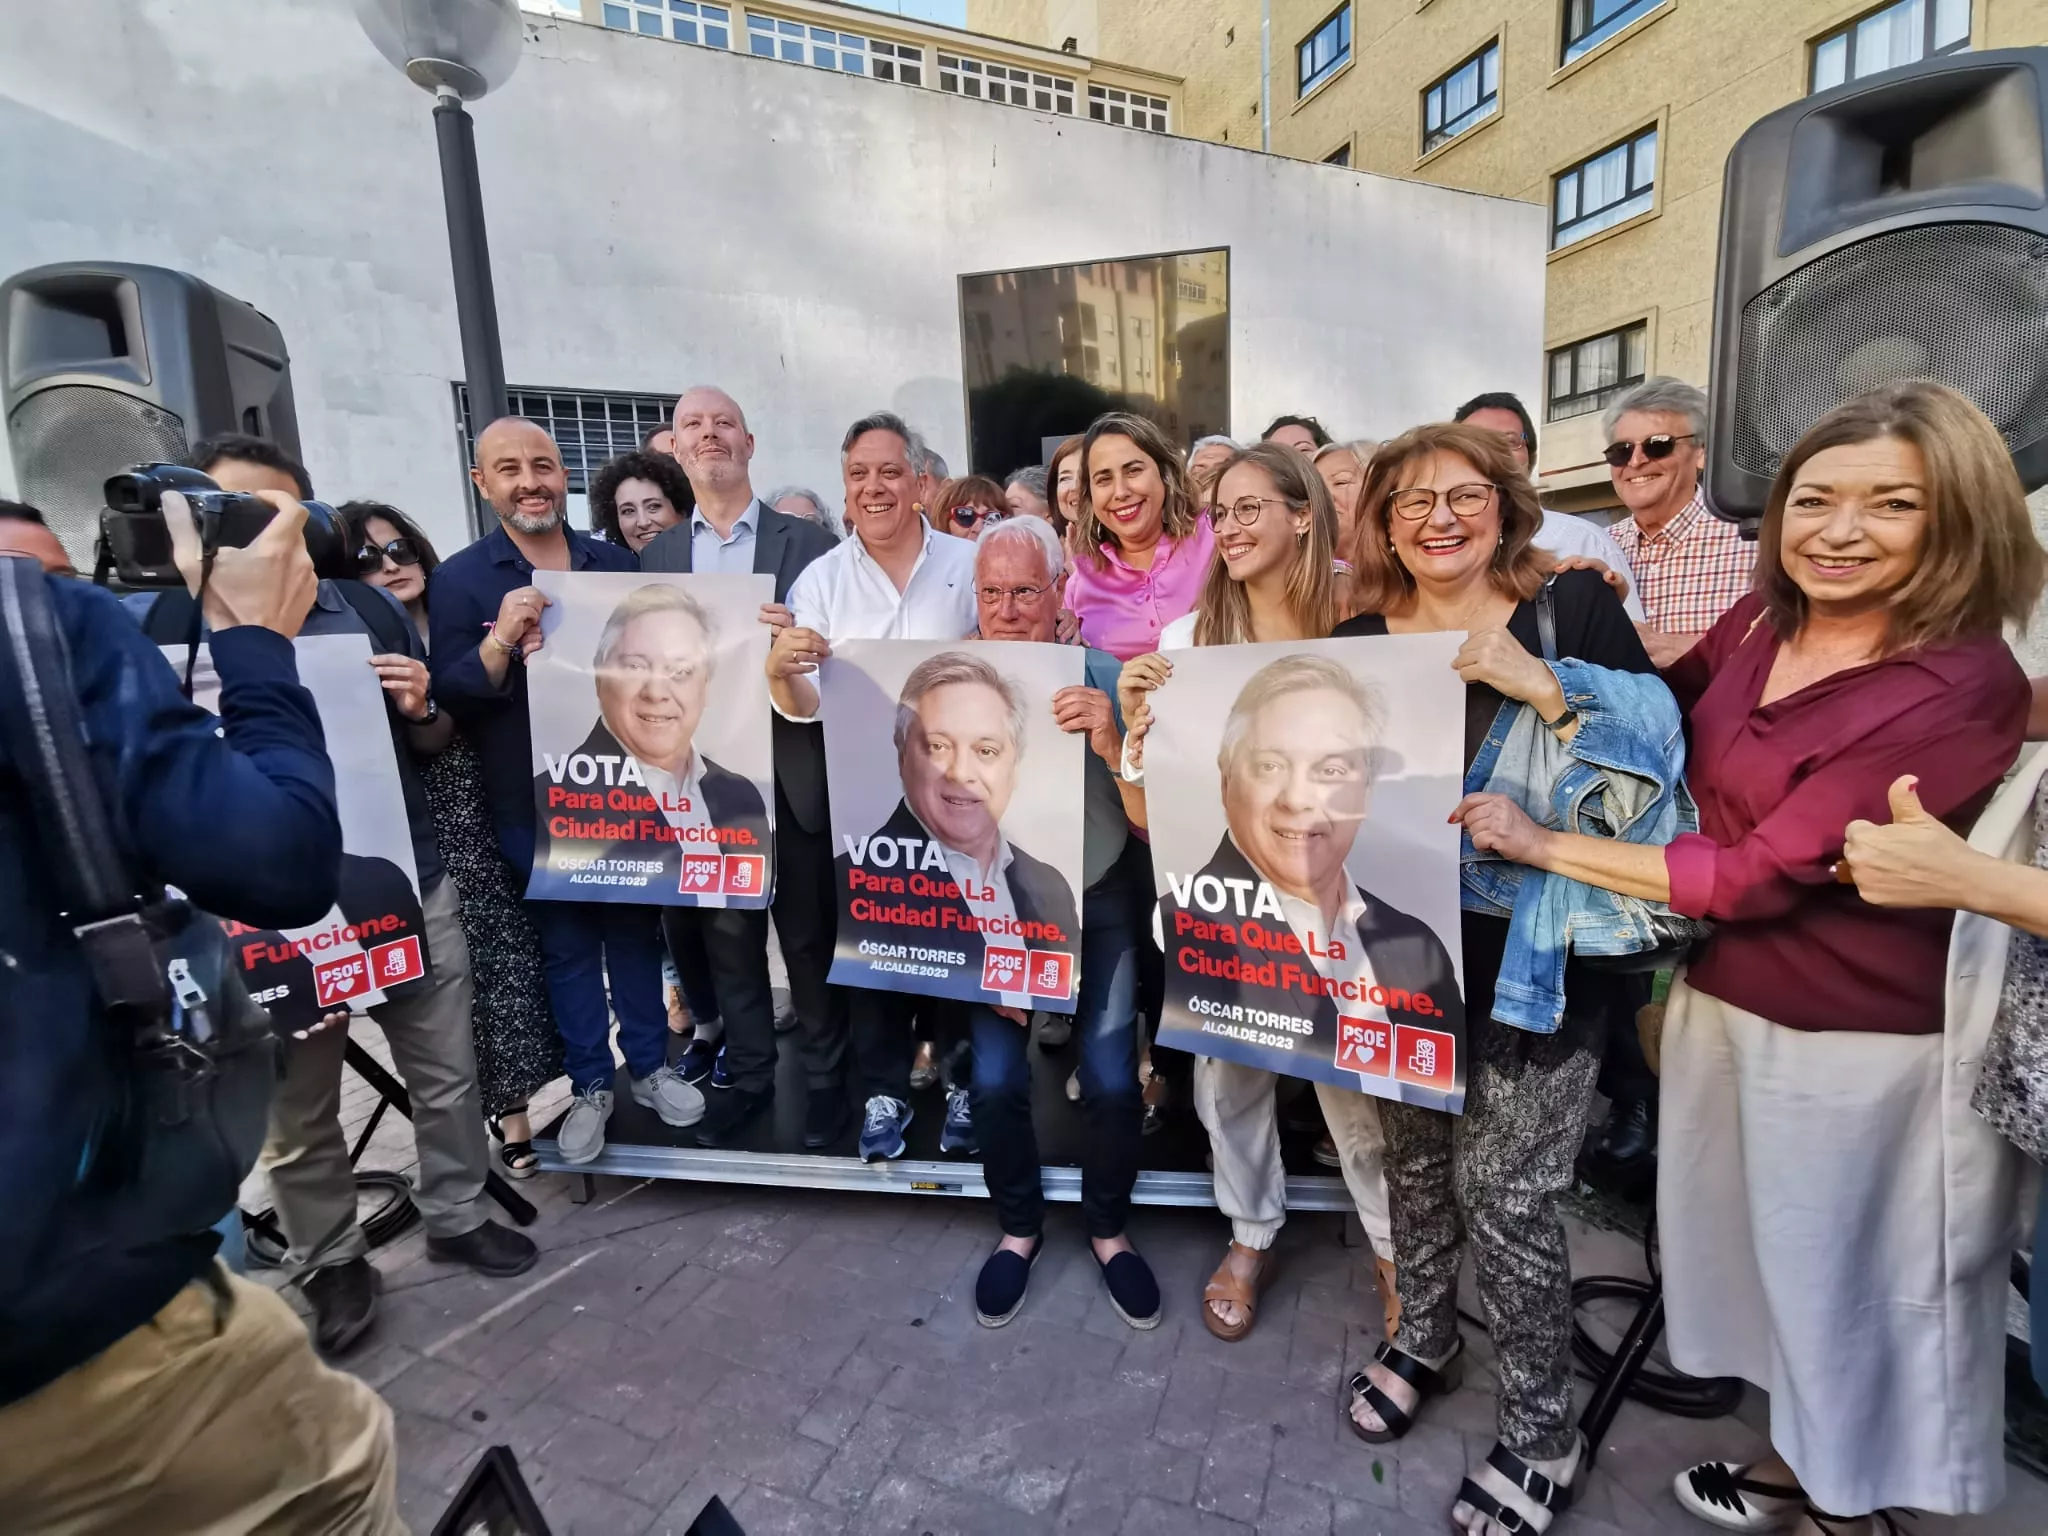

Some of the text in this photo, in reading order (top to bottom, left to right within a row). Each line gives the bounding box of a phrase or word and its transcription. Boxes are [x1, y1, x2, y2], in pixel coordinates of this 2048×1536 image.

[543, 753, 647, 787] VOTA
[548, 787, 691, 813] Para Que La
[549, 816, 758, 846] Ciudad Funcione.
[608, 860, 664, 874] TORRES
[685, 861, 718, 874] PSOE
[843, 834, 950, 873] VOTA
[848, 868, 995, 902] Para Que La
[1165, 871, 1287, 923] VOTA
[849, 898, 1068, 943] Ciudad Funcione.
[242, 912, 408, 971] Funcione.
[1174, 911, 1347, 961] Para Que La
[858, 939, 967, 966] ÓSCAR TORRES
[988, 954, 1023, 971] PSOE
[320, 960, 364, 985] PSOE
[869, 959, 949, 979] ALCALDE 2023
[1177, 946, 1444, 1018] Ciudad Funcione.
[248, 984, 290, 1004] RES
[1188, 995, 1315, 1036] ÓSCAR TORRES
[1201, 1021, 1295, 1051] ALCALDE 2023
[1343, 1024, 1387, 1049] PSOE
